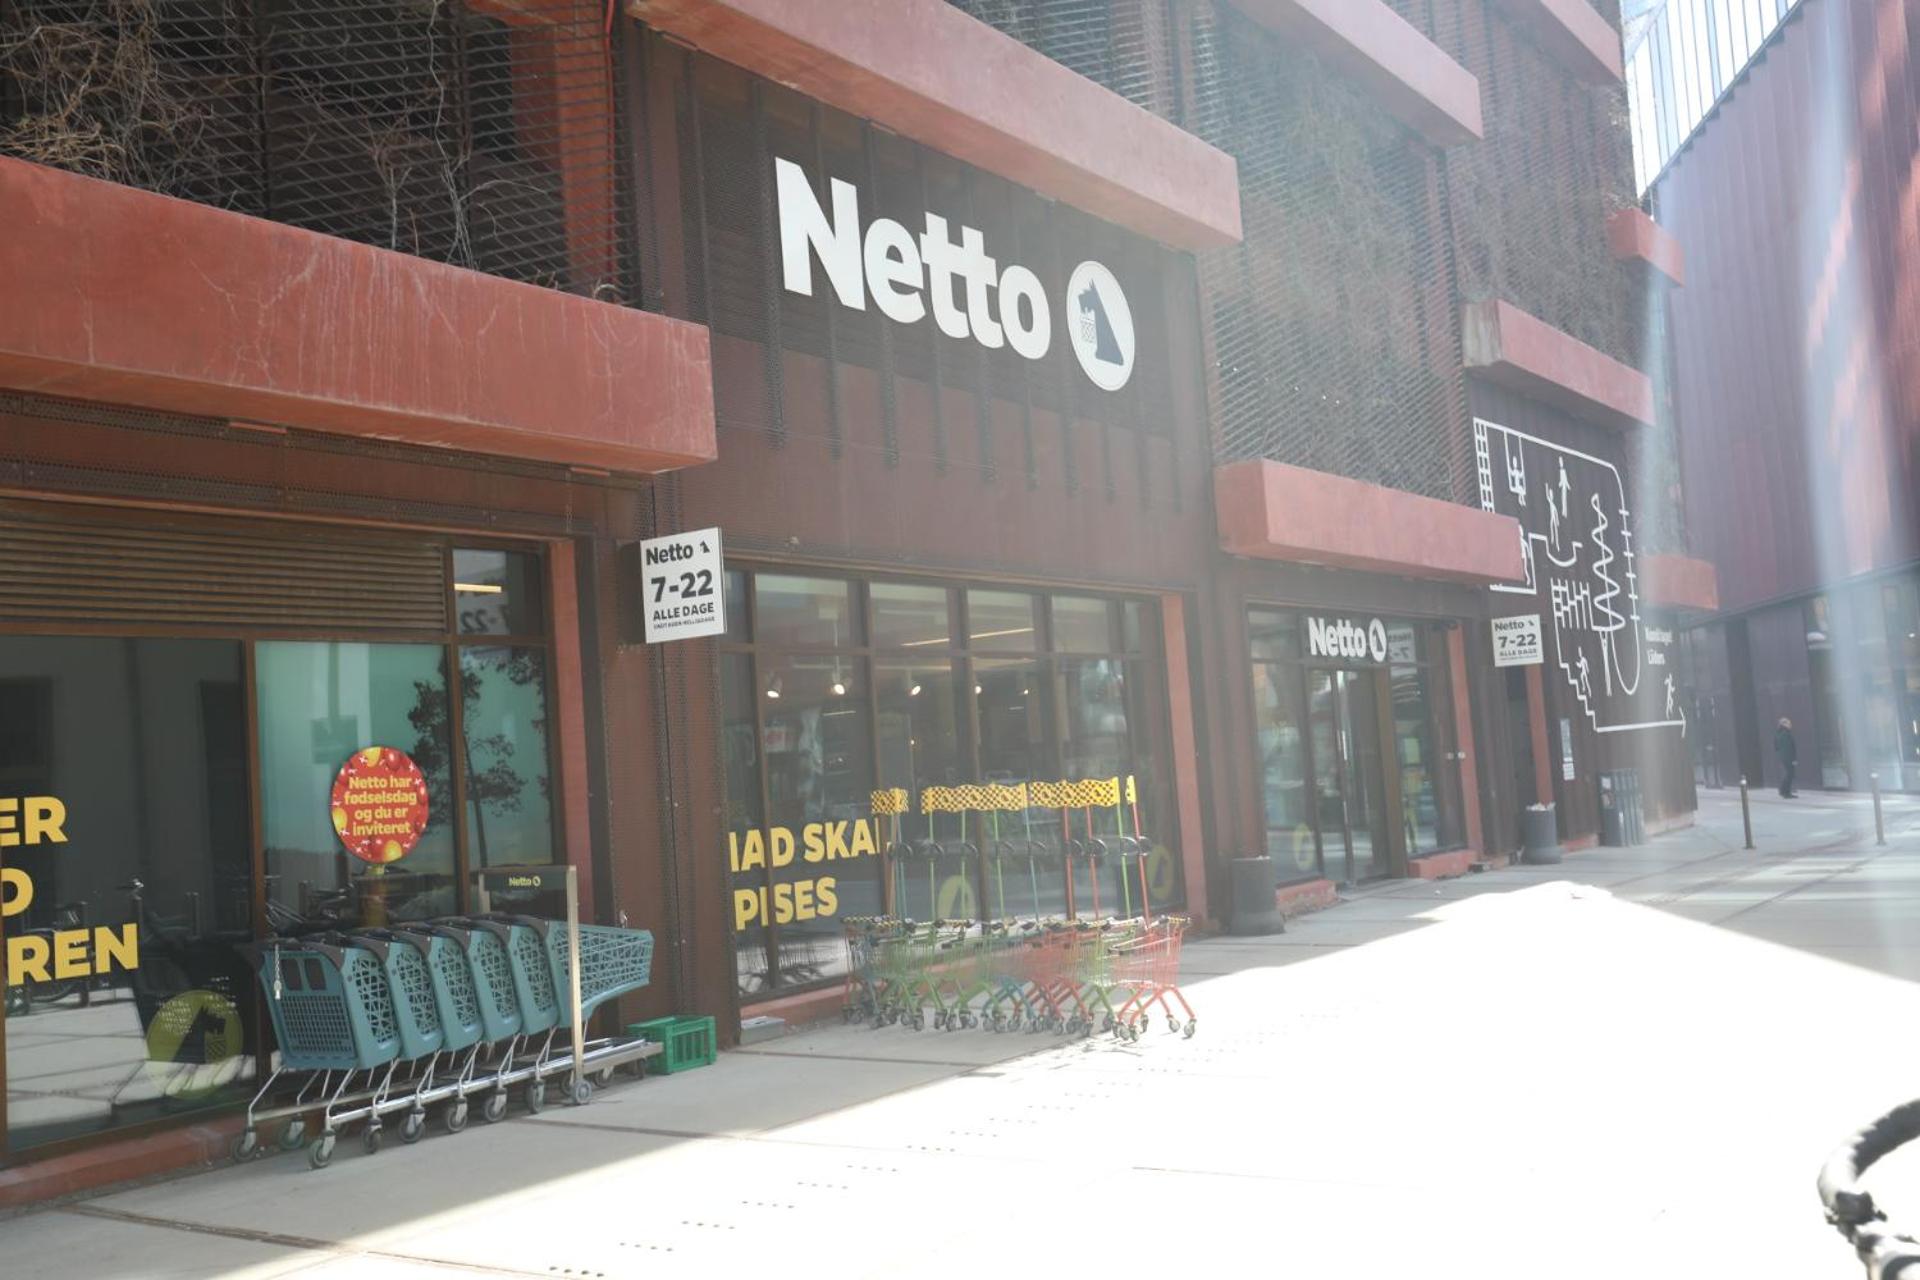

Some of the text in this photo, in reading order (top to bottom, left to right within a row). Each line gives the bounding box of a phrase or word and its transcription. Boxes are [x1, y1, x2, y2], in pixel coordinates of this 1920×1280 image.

[775, 157, 1051, 360] Netto
[646, 543, 694, 565] Netto
[651, 569, 714, 603] 7-22
[653, 602, 715, 621] ALLE DAGE
[1494, 620, 1525, 631] Netto
[1308, 617, 1367, 658] Netto
[1497, 633, 1537, 649] 7-22
[348, 775, 412, 789] Netto har
[354, 805, 409, 822] og du er
[352, 821, 411, 836] inviteret
[803, 818, 881, 863] SKA
